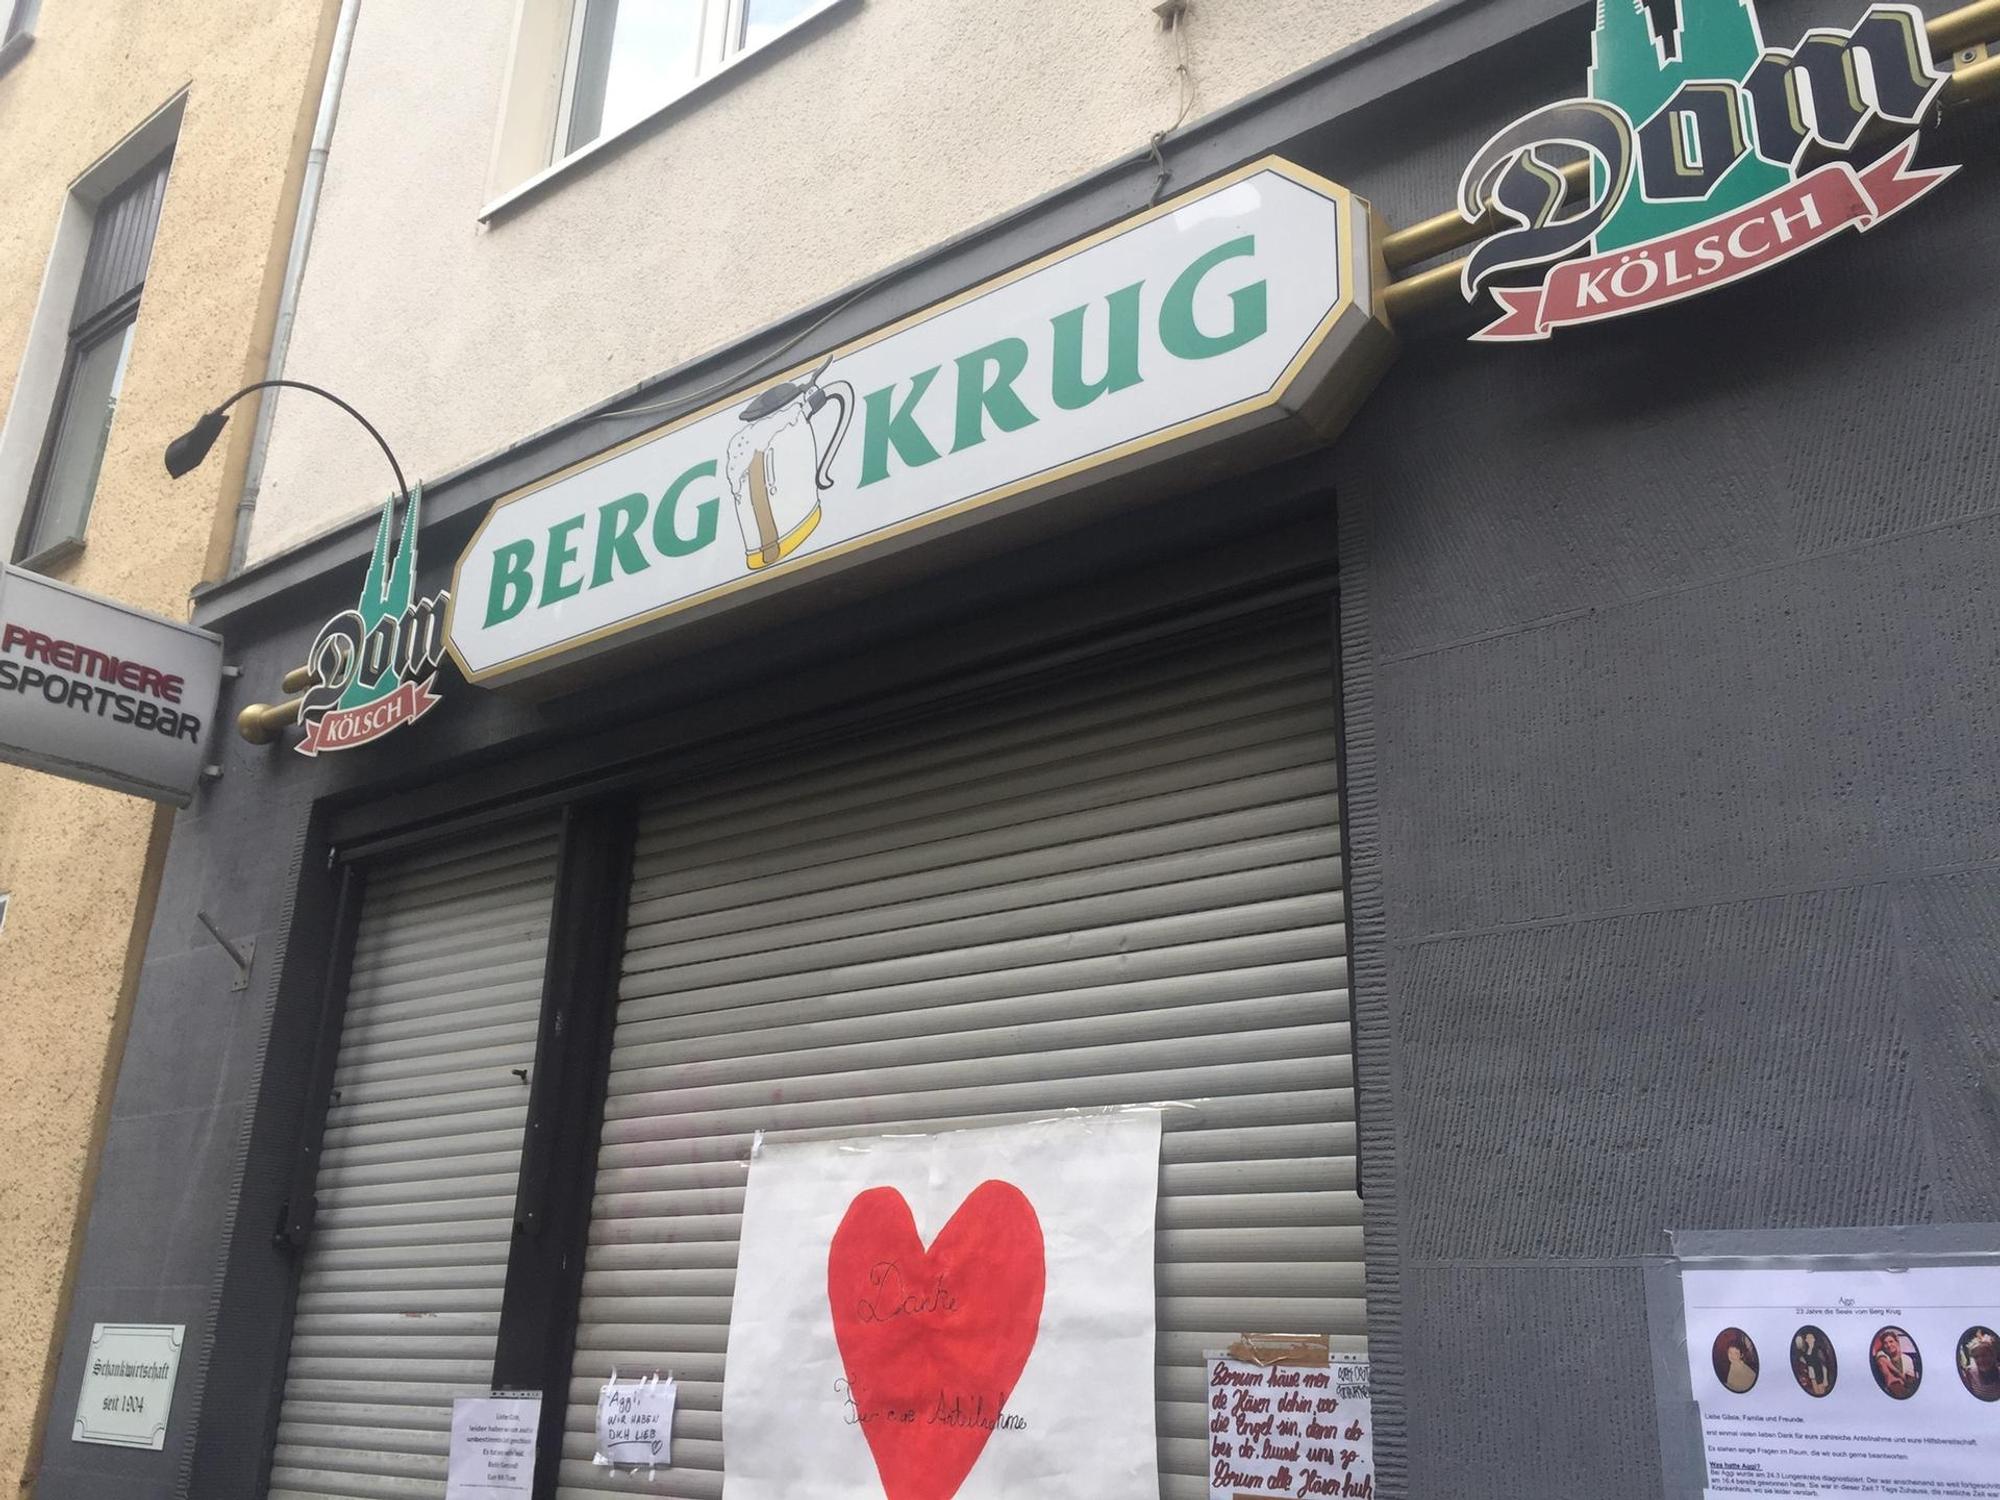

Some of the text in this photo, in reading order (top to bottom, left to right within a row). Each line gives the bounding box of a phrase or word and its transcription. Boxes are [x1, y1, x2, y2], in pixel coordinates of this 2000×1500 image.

[1457, 4, 1952, 303] Dom
[1575, 192, 1824, 308] KÖLSCH
[481, 234, 1270, 630] BERG KRUG
[327, 696, 401, 742] KÖLSCH
[857, 1258, 957, 1323] Danke
[93, 1358, 169, 1381] Schankwirtschaft
[102, 1395, 144, 1413] seit 1904
[1212, 1389, 1227, 1410] de
[631, 1414, 659, 1424] HABEN
[635, 1429, 656, 1440] LIEB
